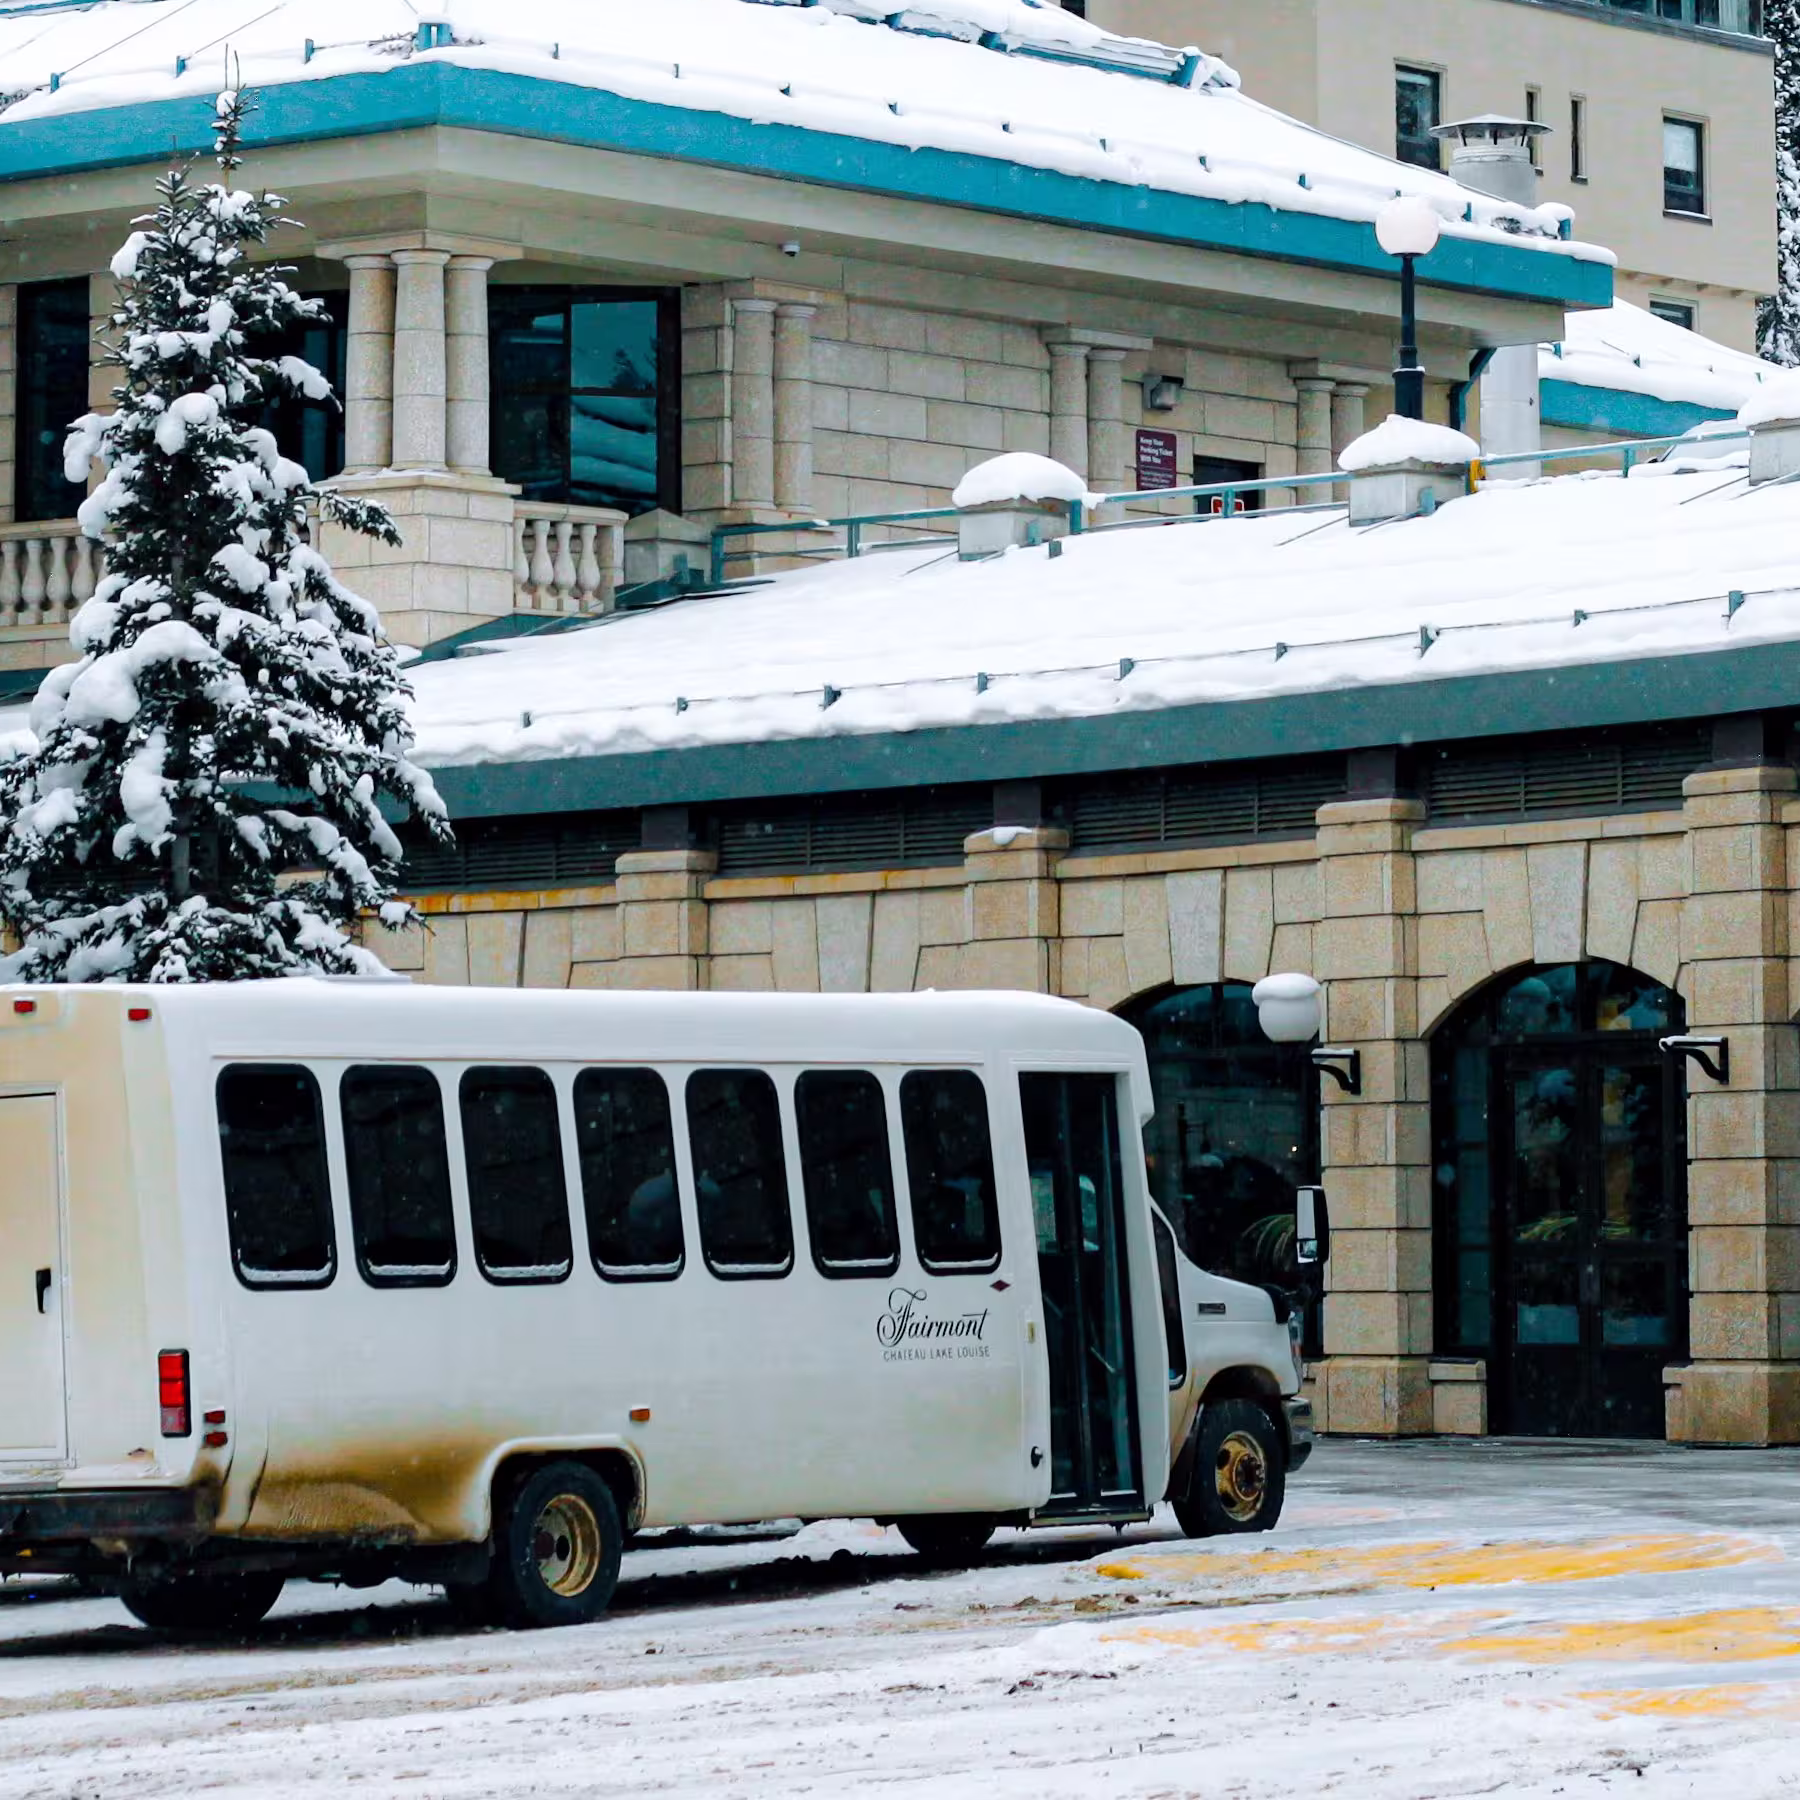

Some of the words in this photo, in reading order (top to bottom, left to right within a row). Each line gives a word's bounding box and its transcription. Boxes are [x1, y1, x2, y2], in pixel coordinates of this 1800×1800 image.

[1140, 445, 1159, 456] Parking
[1159, 448, 1173, 457] Ticket
[876, 1287, 992, 1348] Fairmont
[883, 1348, 926, 1362] CHATEAU
[930, 1347, 953, 1360] LAKE
[957, 1345, 991, 1358] LOUISE
